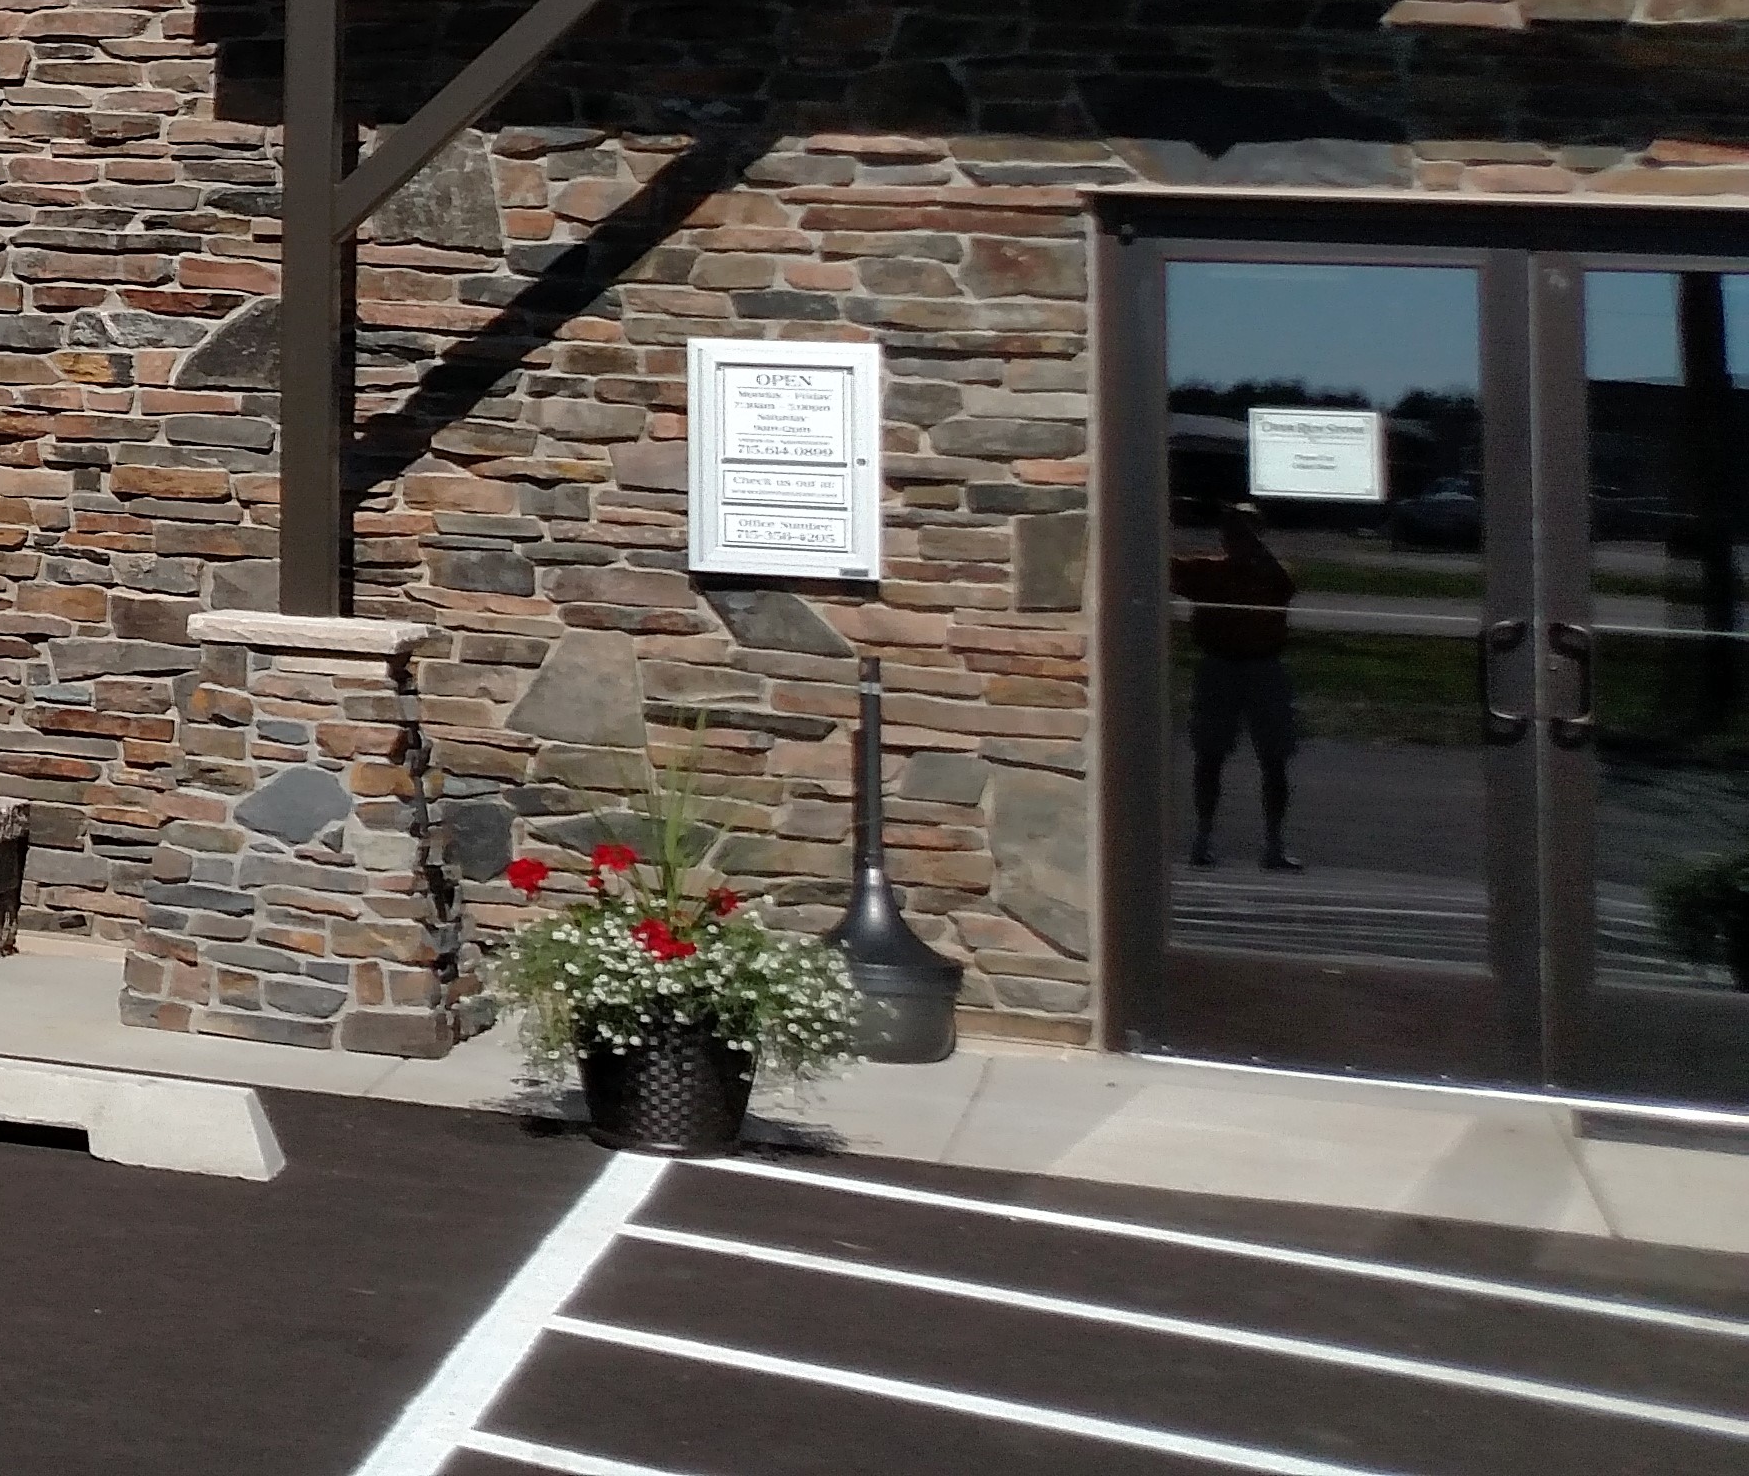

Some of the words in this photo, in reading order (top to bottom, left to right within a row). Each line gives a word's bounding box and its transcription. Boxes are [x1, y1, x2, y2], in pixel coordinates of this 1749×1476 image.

[756, 373, 813, 386] OPEN
[732, 476, 772, 486] Check
[795, 480, 816, 488] out
[738, 518, 775, 528] Office
